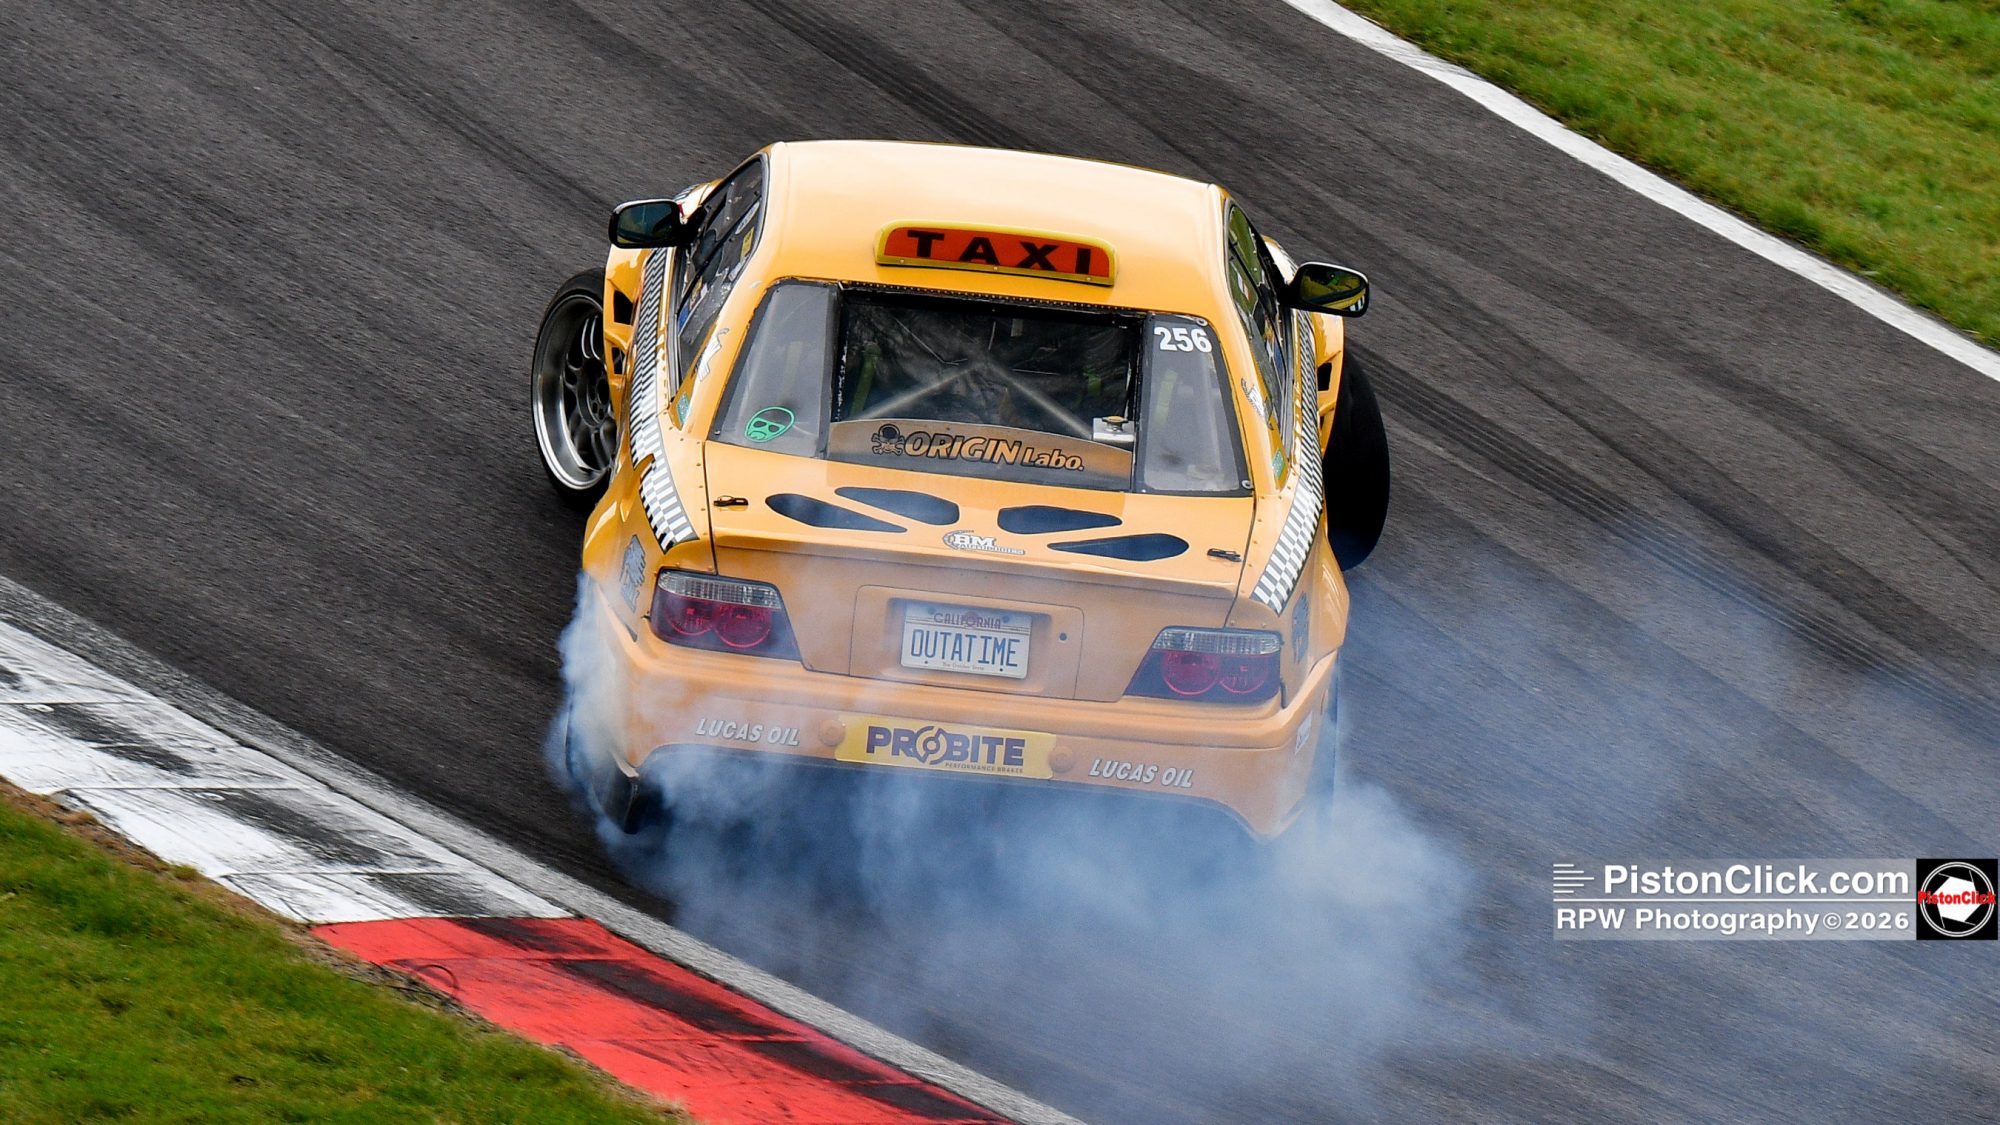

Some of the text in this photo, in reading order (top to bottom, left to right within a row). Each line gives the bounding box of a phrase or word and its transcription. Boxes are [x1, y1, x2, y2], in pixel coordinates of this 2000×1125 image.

[907, 230, 1091, 275] TAXI
[1153, 326, 1213, 353] 256
[903, 431, 1085, 471] ORIGIN Labo.
[953, 533, 997, 547] BM
[933, 612, 1002, 630] CALIFORNIA
[910, 629, 1021, 668] OUTATIME
[695, 718, 801, 747] LUCAS OIL
[866, 725, 1026, 767] PROBITE
[945, 761, 995, 772] PERFORMANCE
[1089, 759, 1195, 789] LUCAS OIL
